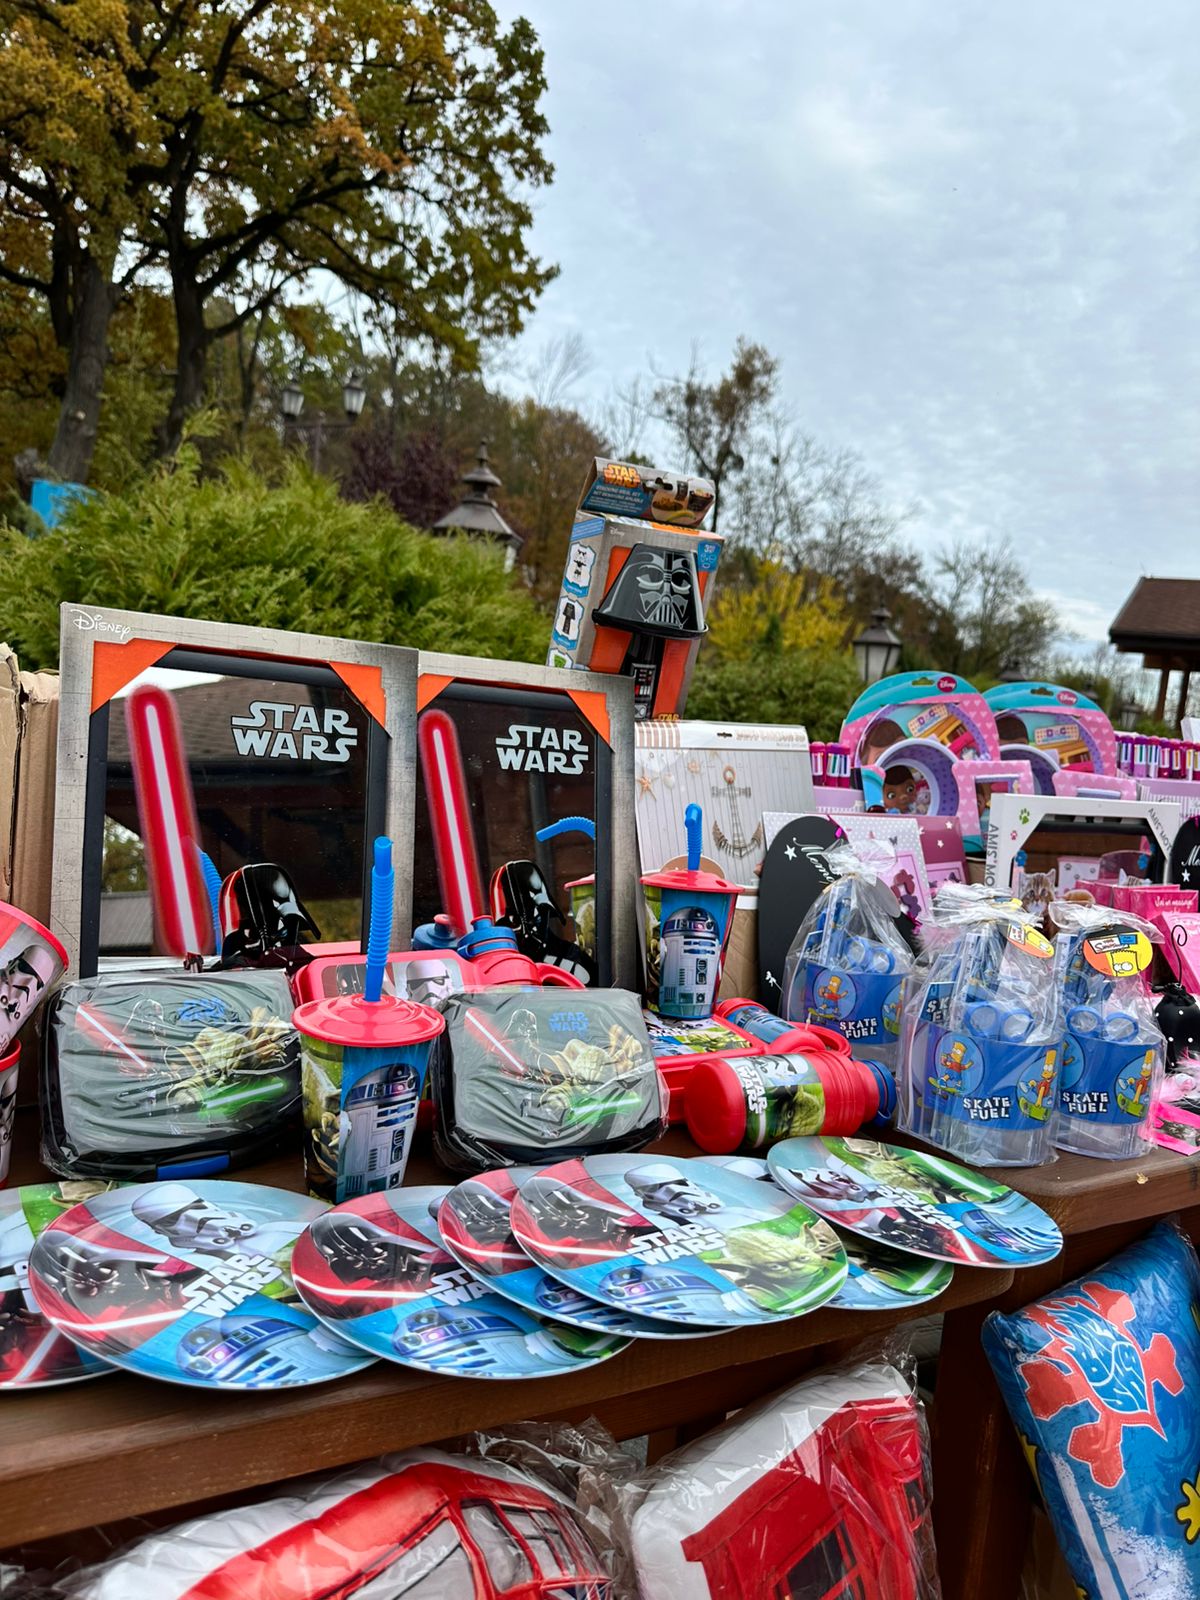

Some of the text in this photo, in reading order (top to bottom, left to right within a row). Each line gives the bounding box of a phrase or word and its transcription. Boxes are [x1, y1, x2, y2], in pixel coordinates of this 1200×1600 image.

[604, 463, 640, 481] STAR
[604, 474, 640, 489] WARS
[231, 700, 358, 736] STAR
[232, 728, 358, 763] WARS
[495, 724, 589, 752] STAR
[496, 747, 589, 775] WARS
[549, 1012, 588, 1021] STAR
[840, 1018, 877, 1030] SKATE
[845, 1026, 877, 1038] FUEL
[736, 1065, 759, 1112] WARS
[748, 1068, 768, 1115] STAR
[1062, 1092, 1109, 1104] SKATE
[963, 1097, 1010, 1110] SKATE
[970, 1107, 1010, 1120] FUEL
[1068, 1102, 1108, 1113] FUEL
[625, 1223, 717, 1254] STAR
[632, 1233, 727, 1266] WARS
[181, 1254, 266, 1310] STAR
[192, 1258, 283, 1318] WARS
